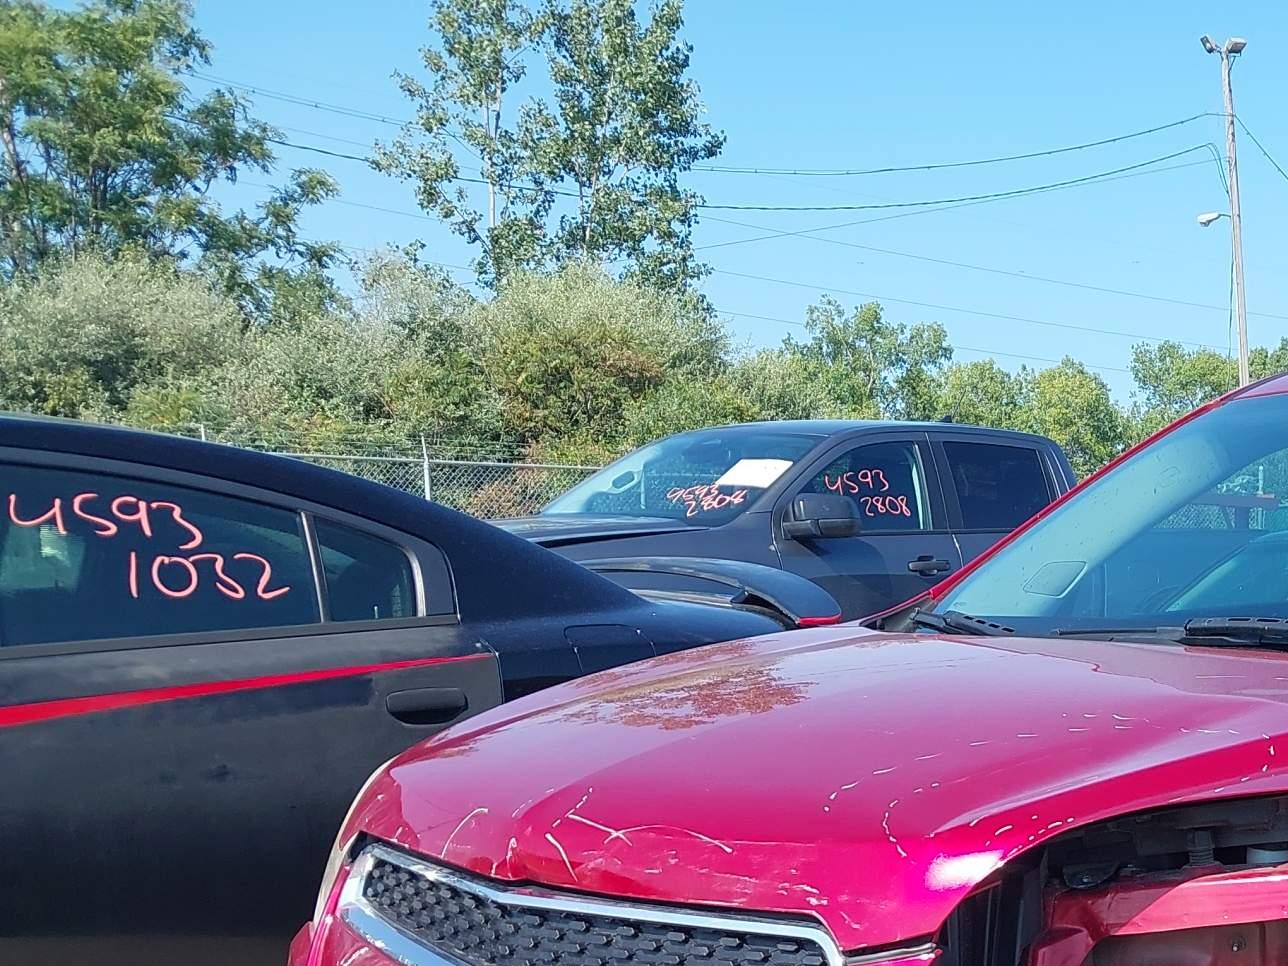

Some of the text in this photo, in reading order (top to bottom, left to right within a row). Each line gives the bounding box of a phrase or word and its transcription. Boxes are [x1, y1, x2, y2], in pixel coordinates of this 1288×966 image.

[824, 469, 889, 496] 4593
[9, 493, 202, 549] 4593
[860, 495, 912, 517] 2808
[129, 551, 290, 599] 1032
